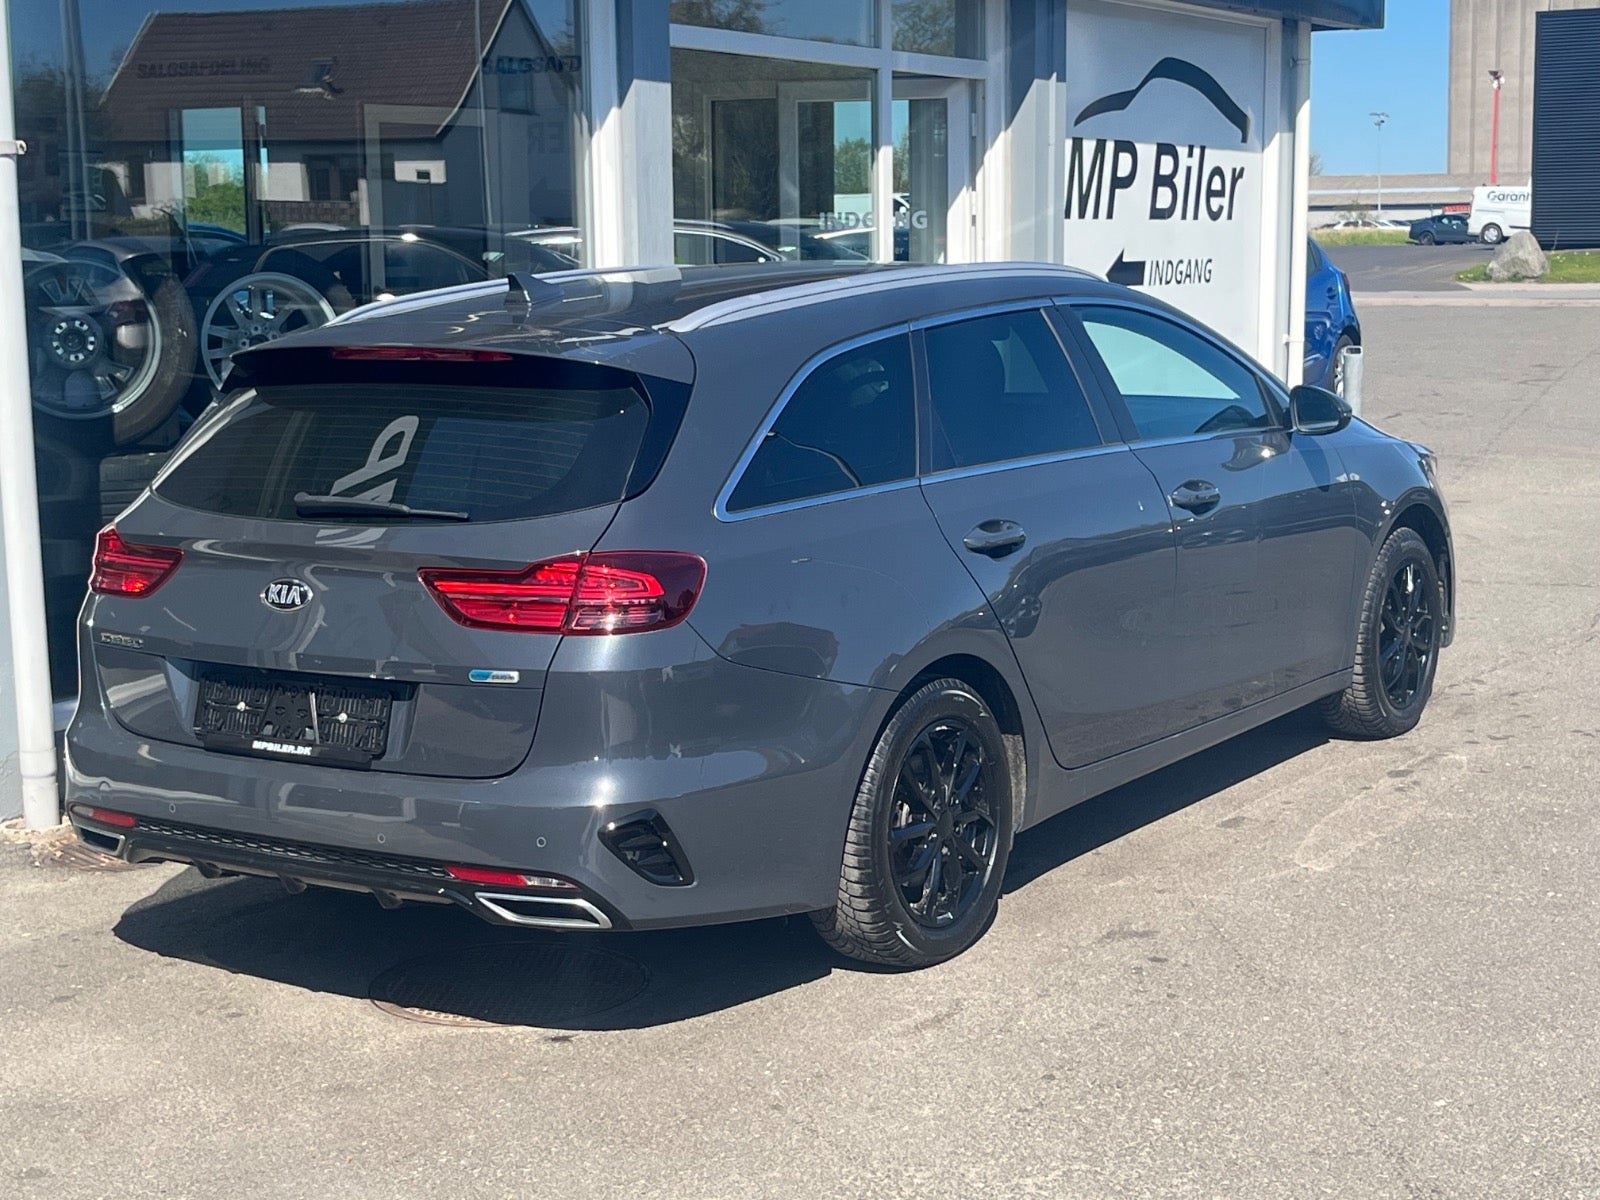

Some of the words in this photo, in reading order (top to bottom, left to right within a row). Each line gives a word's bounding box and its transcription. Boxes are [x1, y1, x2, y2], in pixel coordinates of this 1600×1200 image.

[1064, 137, 1138, 220] MP
[1149, 142, 1245, 221] Biler
[819, 210, 928, 230] INDGNG
[1149, 258, 1213, 286] INDGANG
[267, 583, 301, 605] KIA
[252, 740, 312, 756] MPBILER.DK
